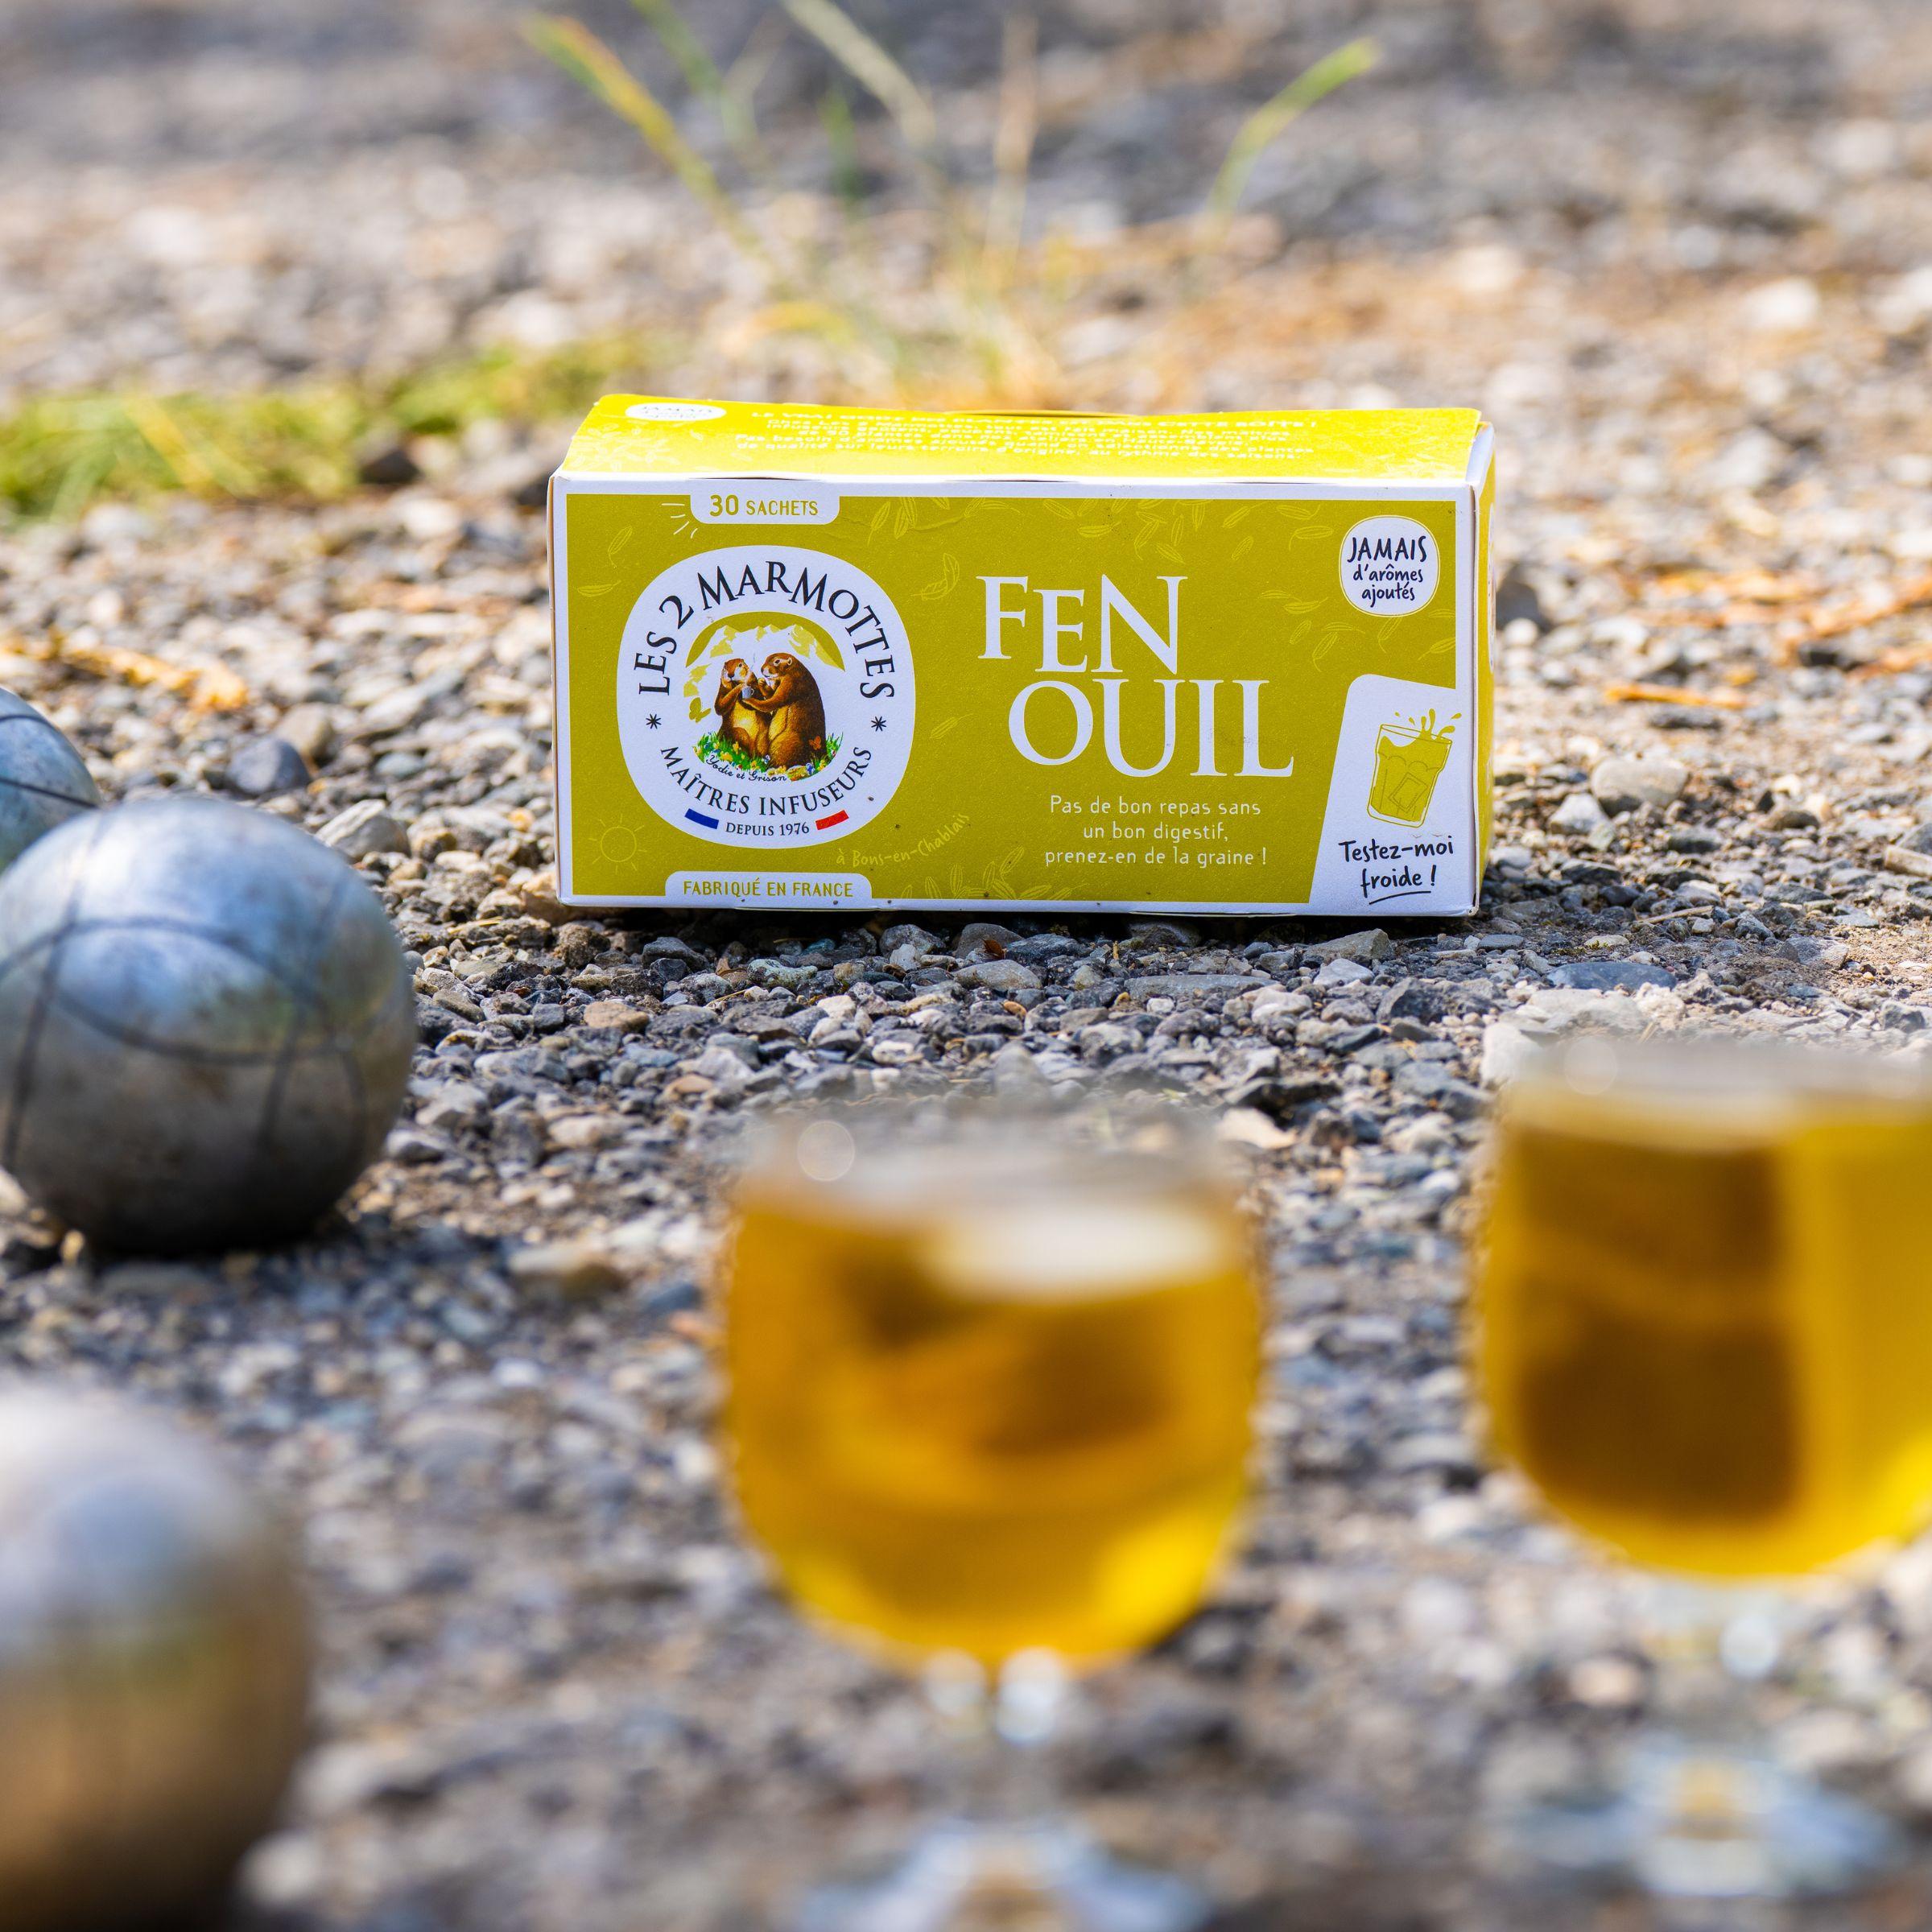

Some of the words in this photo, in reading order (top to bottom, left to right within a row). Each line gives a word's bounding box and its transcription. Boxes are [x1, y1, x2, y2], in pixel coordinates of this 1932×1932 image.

[709, 494, 739, 517] 30
[746, 500, 819, 517] SACHETS
[1347, 535, 1427, 564] JAMAIS
[1352, 564, 1424, 582] d'arômes
[1361, 582, 1416, 609] ajoutés
[634, 630, 678, 696] LES
[658, 595, 695, 630] 2
[697, 560, 895, 699] MARMOTTES
[976, 574, 1188, 675] FEN
[1009, 679, 1294, 778] OUIL
[660, 745, 749, 815] MAÎTRES
[759, 745, 873, 815] INFUSEURS
[1050, 795, 1082, 814] Pas
[1090, 795, 1111, 814] de
[1119, 796, 1152, 815] bon
[1160, 800, 1211, 818] repas
[1219, 800, 1261, 815] sans
[725, 821, 775, 836] DEPUIS
[779, 821, 810, 836] 1976
[836, 848, 845, 865] à
[852, 812, 971, 868] Bons-en-Chablais
[1084, 825, 1104, 840] un
[1113, 821, 1145, 840] bon
[1154, 822, 1228, 843] digestif,
[1046, 849, 1136, 867] prenez-en
[1145, 846, 1166, 865] de
[1174, 846, 1189, 865] la
[1197, 847, 1254, 869] graine
[1263, 847, 1268, 866] !
[1338, 835, 1454, 864] Testez-moi
[683, 877, 760, 898] FABRIQUÉ
[767, 882, 787, 898] EN
[793, 882, 853, 898] FRANCE
[1360, 865, 1422, 898] froide
[1430, 865, 1438, 887] !
